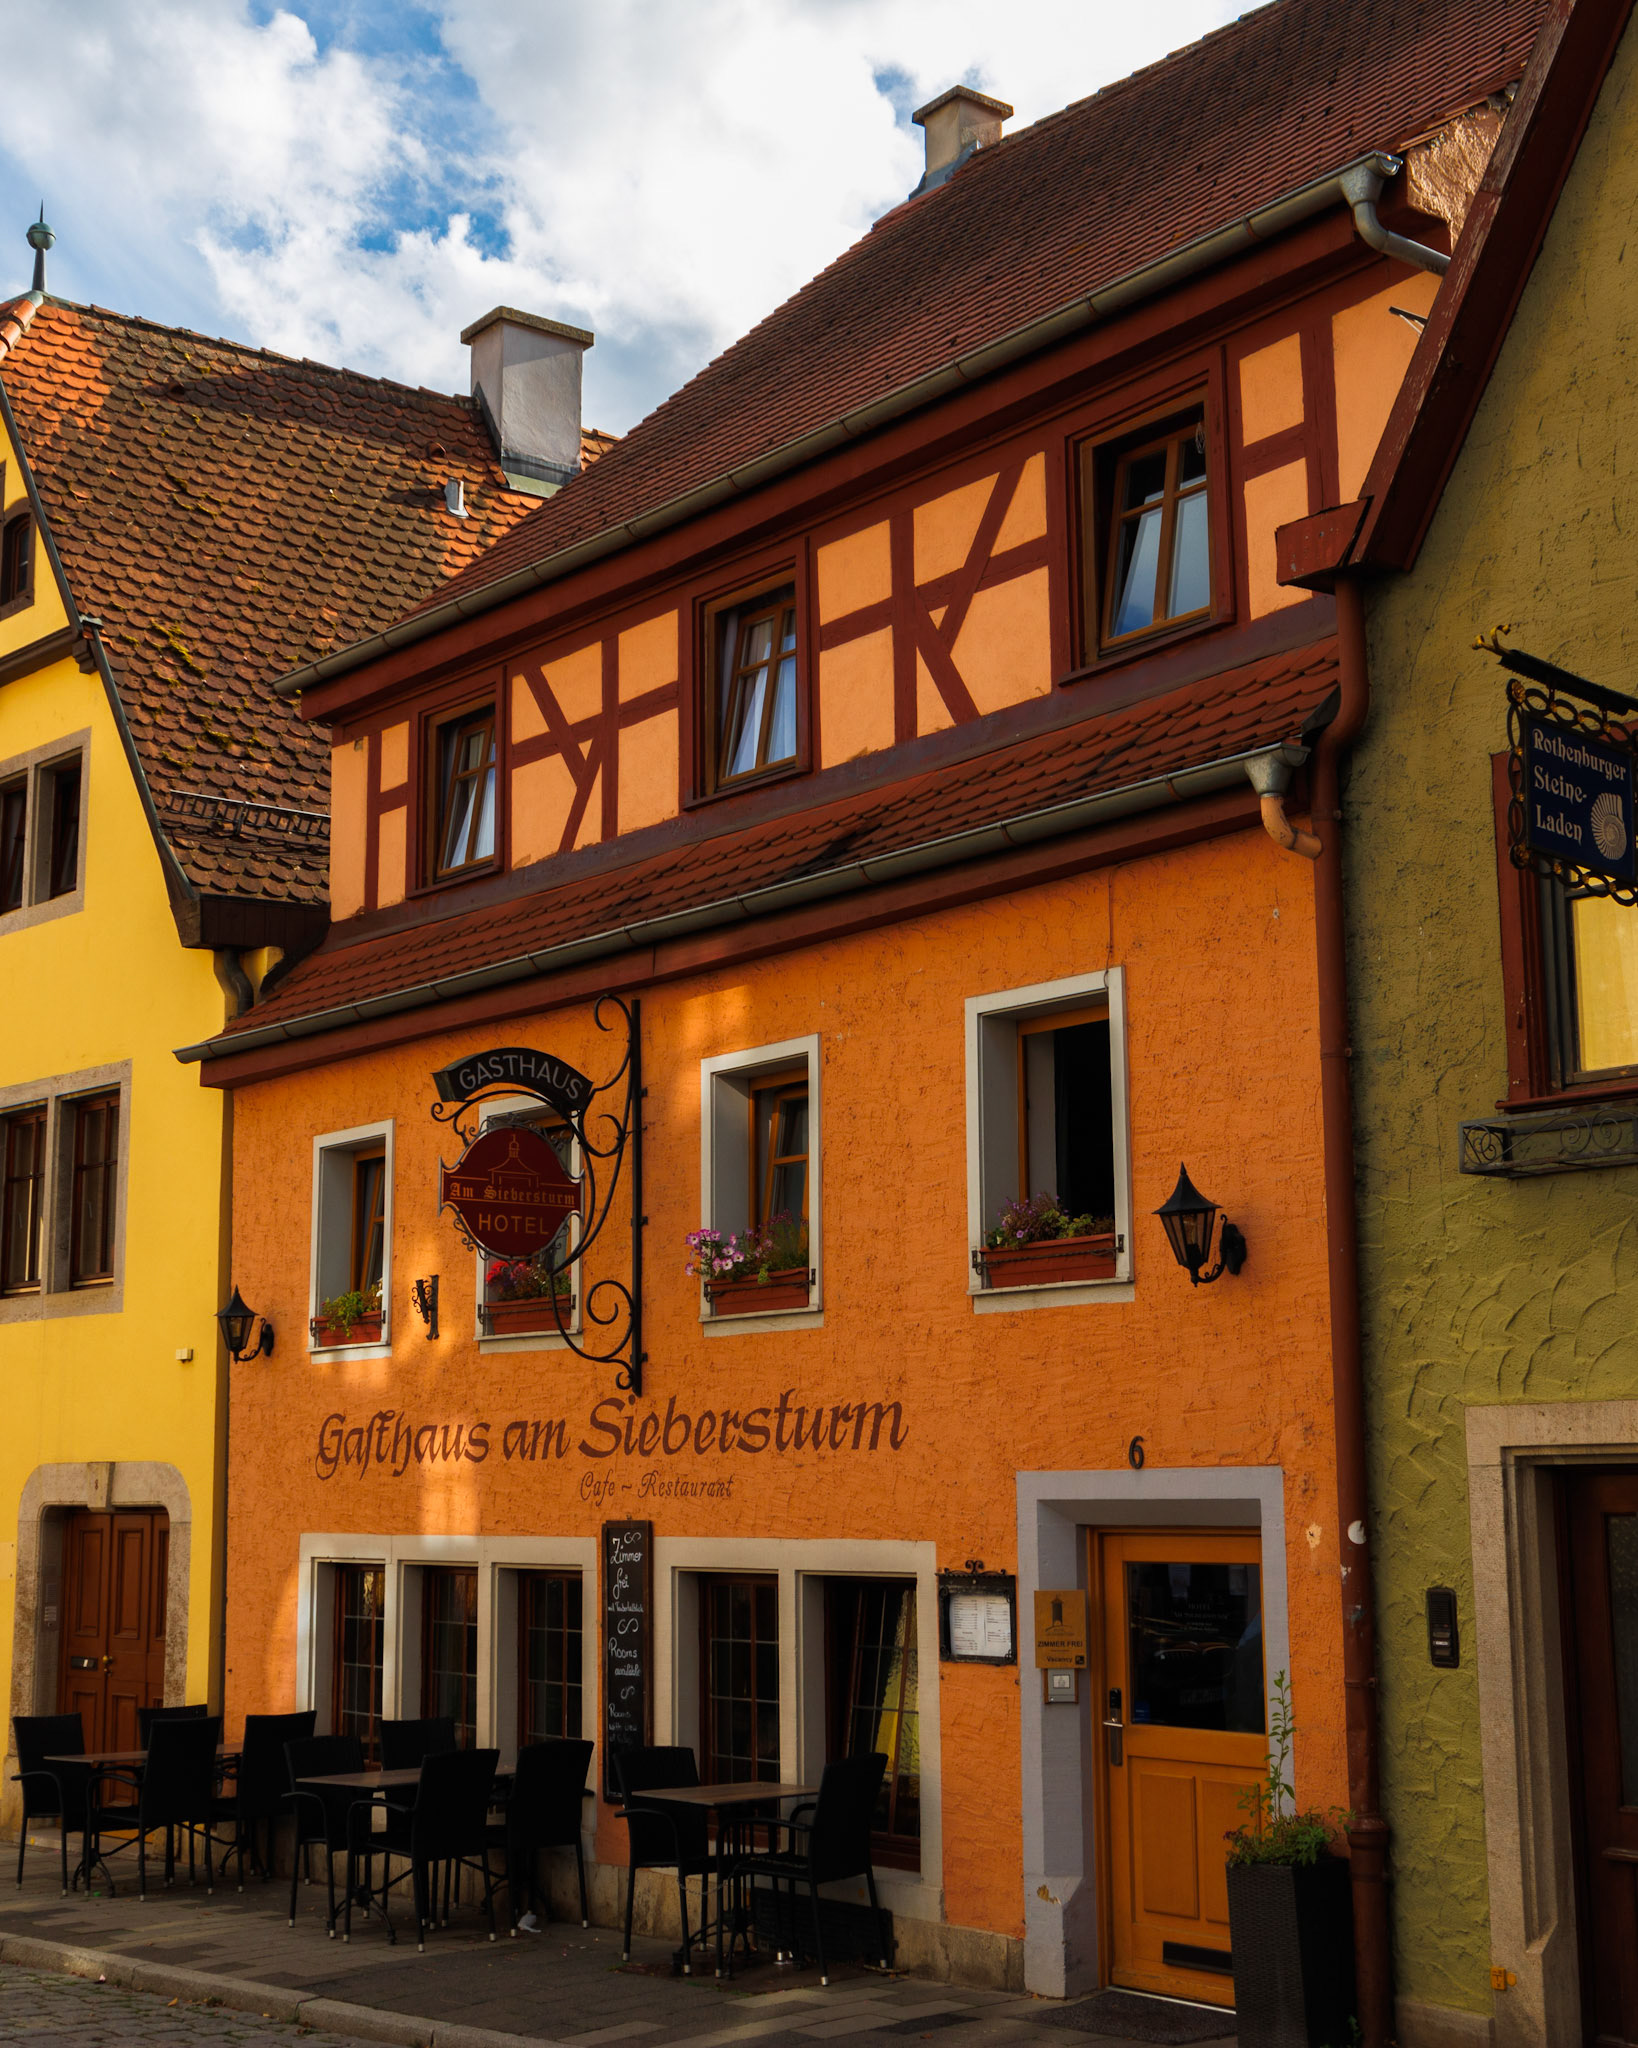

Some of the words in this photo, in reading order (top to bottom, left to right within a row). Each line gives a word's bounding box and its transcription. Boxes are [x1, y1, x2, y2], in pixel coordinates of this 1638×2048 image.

[1533, 728, 1626, 782] Rothenburger
[1533, 764, 1587, 804] Steine-
[1535, 803, 1583, 846] Laden
[459, 1054, 583, 1100] GASTHAUS
[449, 1182, 474, 1198] Am
[484, 1184, 575, 1206] Siebersturm
[478, 1213, 550, 1235] HOTEL
[502, 1417, 571, 1462] am
[578, 1388, 910, 1459] Siebersturm
[1129, 1435, 1144, 1469] 6
[580, 1468, 616, 1507] Cafe
[638, 1469, 735, 1499] Restaurant
[610, 1537, 642, 1565] Zimmer
[612, 1567, 630, 1600] frei
[608, 1637, 638, 1659] Rooms
[1037, 1640, 1065, 1648] ZIMMER
[1067, 1640, 1083, 1648] FREI
[1046, 1656, 1073, 1664] Vacancy
